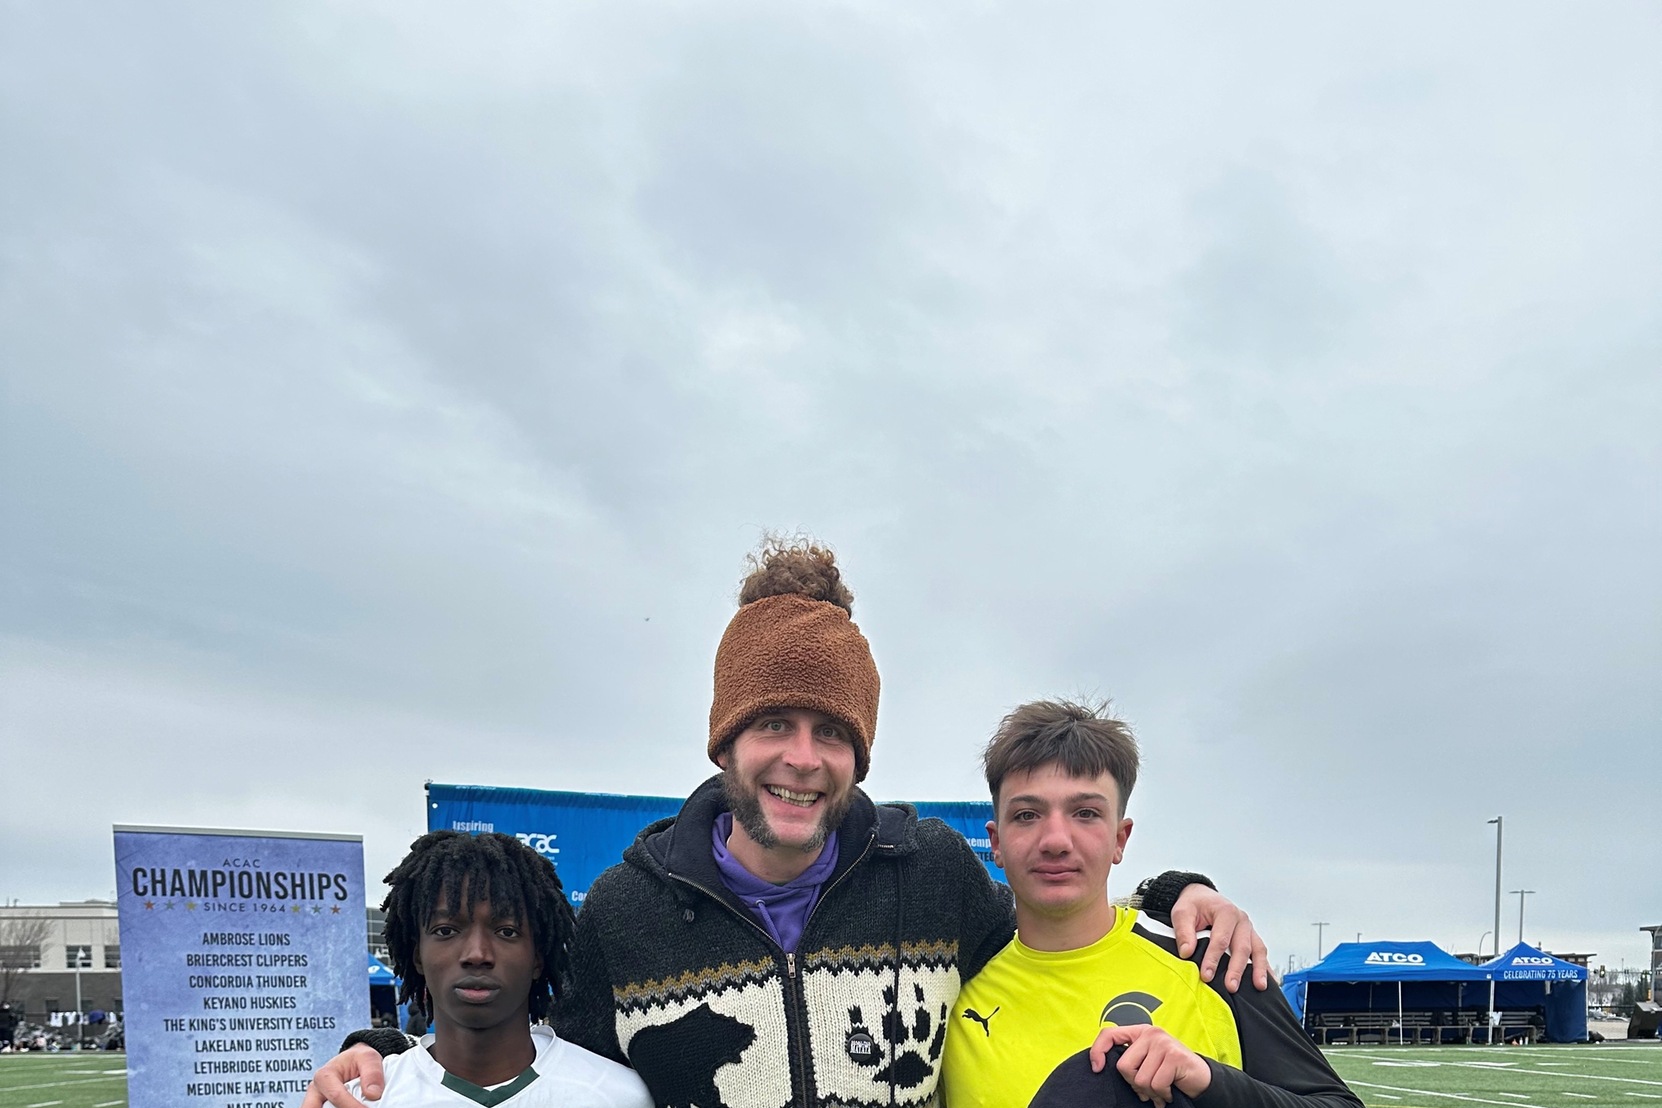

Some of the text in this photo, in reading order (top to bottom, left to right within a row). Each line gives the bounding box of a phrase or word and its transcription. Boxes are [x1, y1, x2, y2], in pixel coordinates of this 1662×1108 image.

[223, 858, 261, 869] ACAC
[132, 867, 348, 901] CHAMPIONSHIPS
[203, 902, 286, 914] SINCE 1964
[202, 932, 291, 946] AMBROSE LIONS
[186, 953, 308, 968] BRIERCREST CLIPPERS
[1366, 951, 1424, 964] ATCO
[1512, 956, 1553, 965] ATCO
[1503, 969, 1578, 980] CELEBRATING 75 YEARS
[189, 975, 308, 989] CONCORDIA THUNDER
[203, 996, 296, 1010] KEYANO HUSKIES
[163, 1016, 336, 1032] THE KING'S UNIVERSITY EAGLES
[195, 1038, 309, 1053] LAKELAND RUSTLERS
[194, 1058, 312, 1075] LETHBRIDGE KODIAKS
[187, 1081, 243, 1097] MEDICINE
[245, 1081, 266, 1095] HAT
